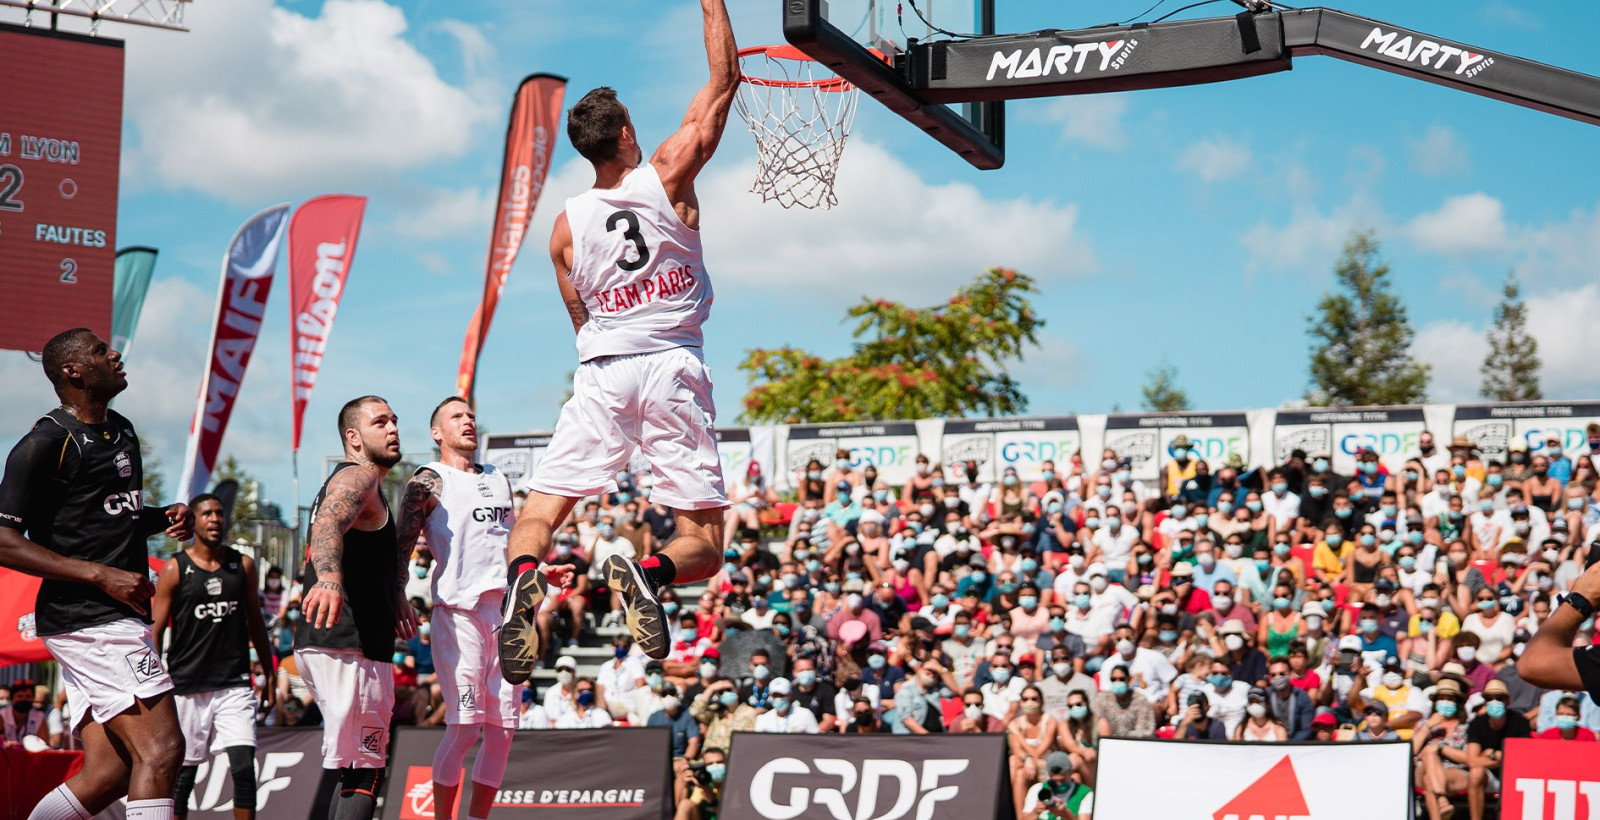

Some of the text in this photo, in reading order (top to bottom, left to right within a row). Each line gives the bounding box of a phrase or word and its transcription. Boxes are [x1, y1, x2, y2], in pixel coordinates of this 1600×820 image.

[986, 38, 1139, 81] MARTY Sports
[1360, 27, 1495, 78] MARTY Sports
[21, 135, 80, 164] LYON
[36, 223, 107, 248] FAUTES
[605, 210, 650, 272] 3
[59, 257, 78, 283] 2
[595, 264, 695, 313] TEAM PARIS
[202, 277, 266, 433] MAIF
[1002, 441, 1072, 462] GRDF
[103, 489, 144, 515] GRD
[472, 506, 511, 523] GRDF
[194, 600, 238, 620] GRDF
[494, 788, 646, 804] ISSE D'EPARGNE
[749, 757, 970, 820] GRDF
